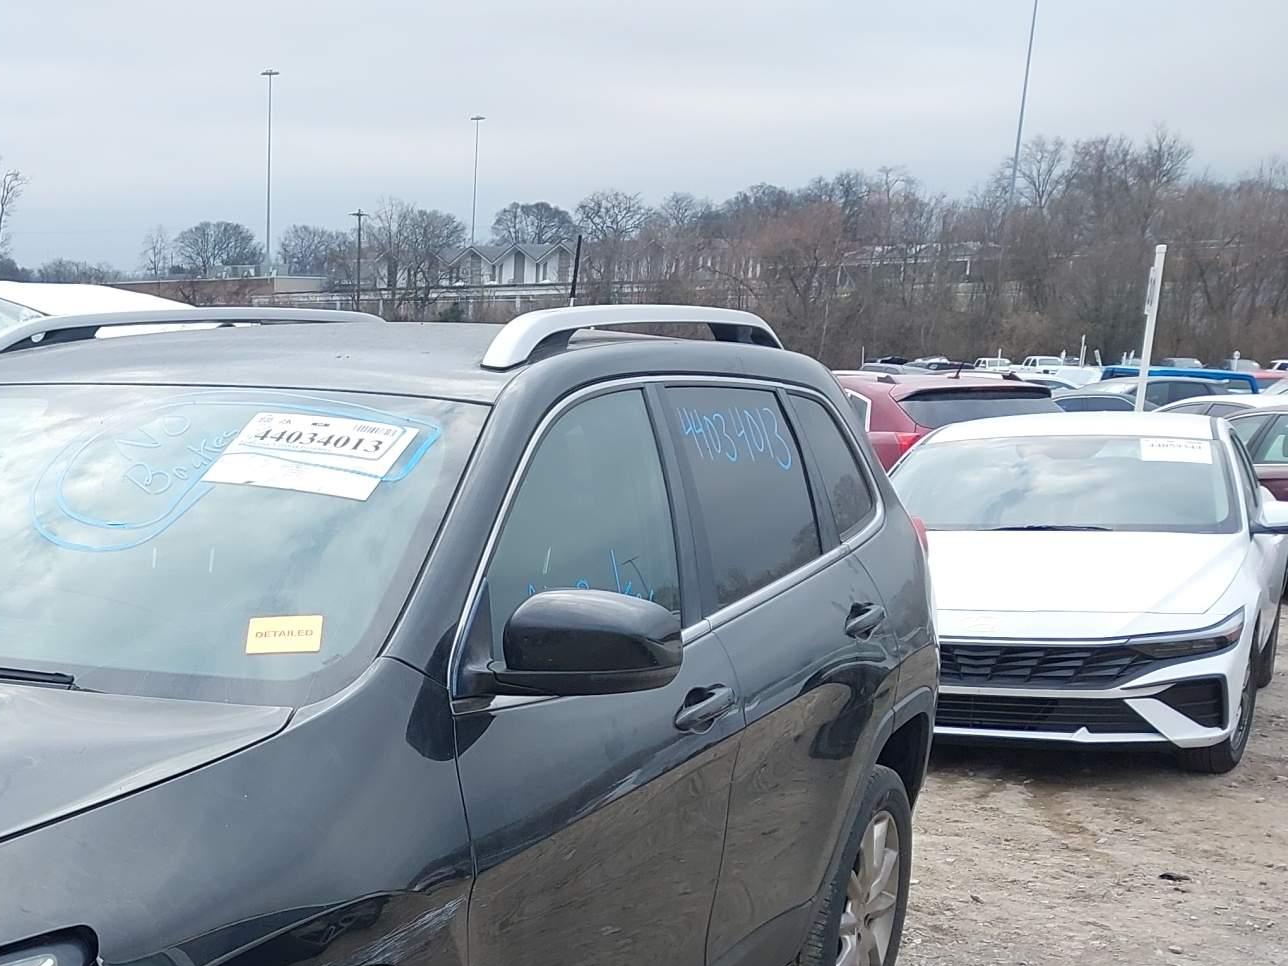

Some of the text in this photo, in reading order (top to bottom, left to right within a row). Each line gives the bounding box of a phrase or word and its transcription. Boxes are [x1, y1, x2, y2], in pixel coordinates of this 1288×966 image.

[254, 427, 384, 454] 44034013
[676, 407, 792, 470] 44034013
[255, 629, 314, 638] DETAILED
